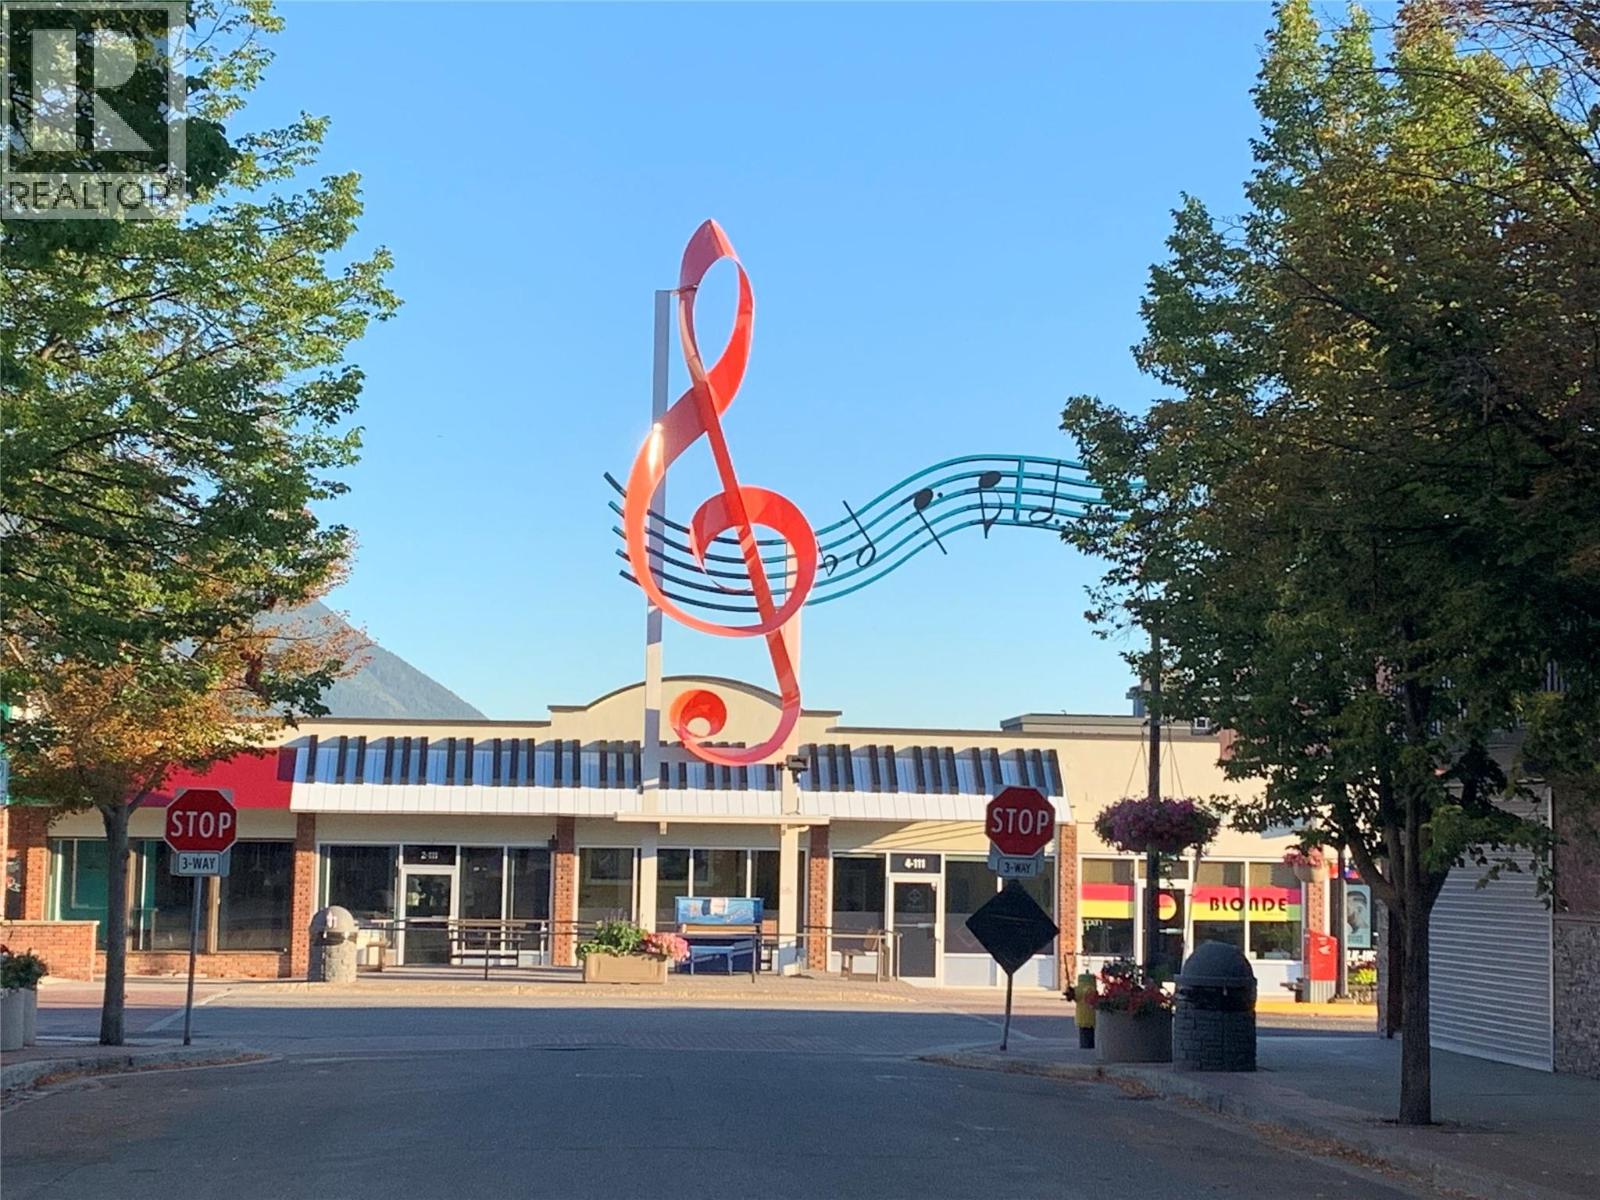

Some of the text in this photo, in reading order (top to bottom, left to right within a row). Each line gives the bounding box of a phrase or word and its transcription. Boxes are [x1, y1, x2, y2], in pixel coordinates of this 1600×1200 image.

[170, 810, 232, 838] STOP
[991, 807, 1049, 835] STOP
[182, 856, 215, 870] 3-WAY
[904, 857, 926, 869] 4-111
[1003, 862, 1031, 873] 3-WAY
[1209, 896, 1287, 912] BLONDE
